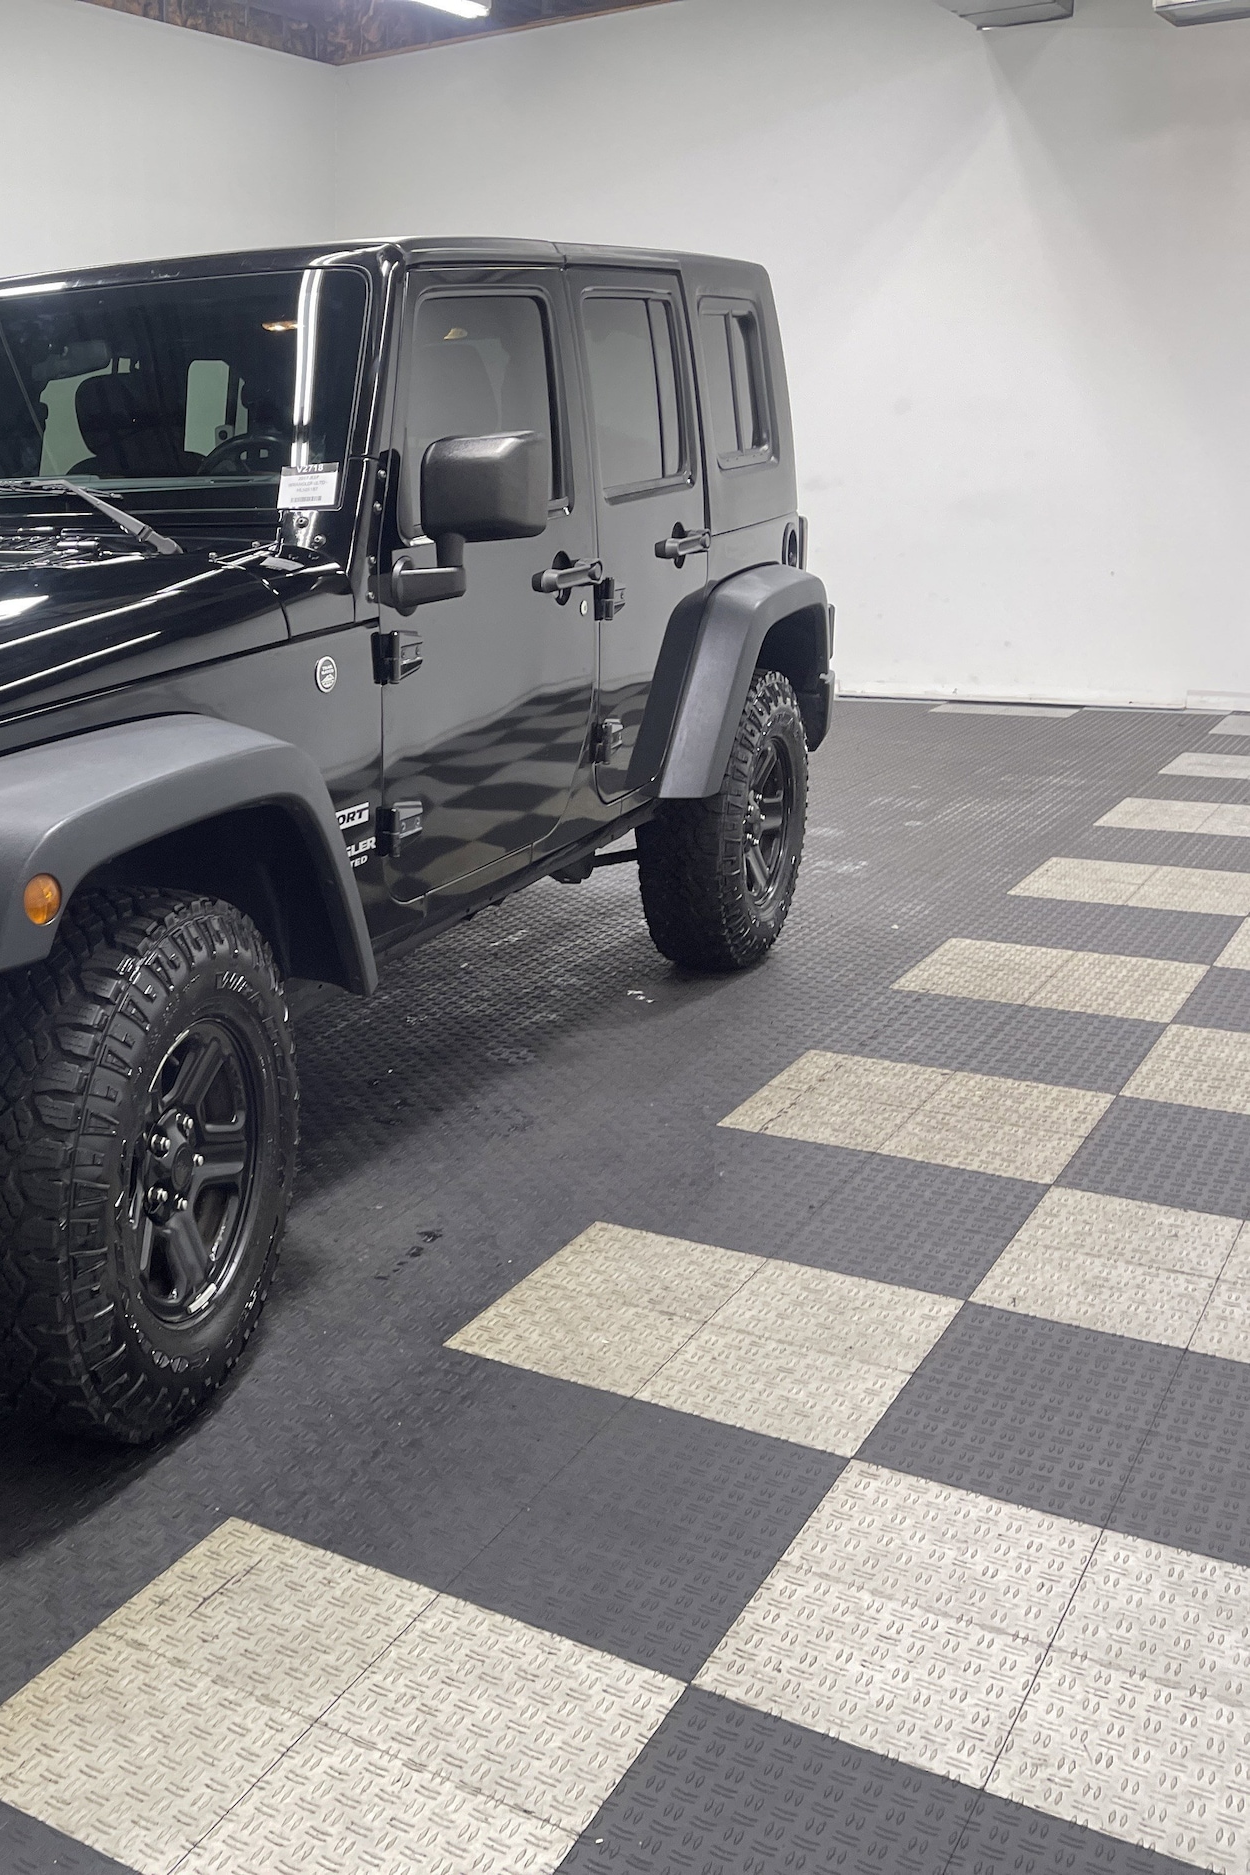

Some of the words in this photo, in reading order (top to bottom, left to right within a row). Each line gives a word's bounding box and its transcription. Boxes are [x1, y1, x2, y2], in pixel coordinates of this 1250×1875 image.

[296, 464, 324, 473] V2718
[337, 808, 367, 826] ORT
[351, 855, 368, 868] TED
